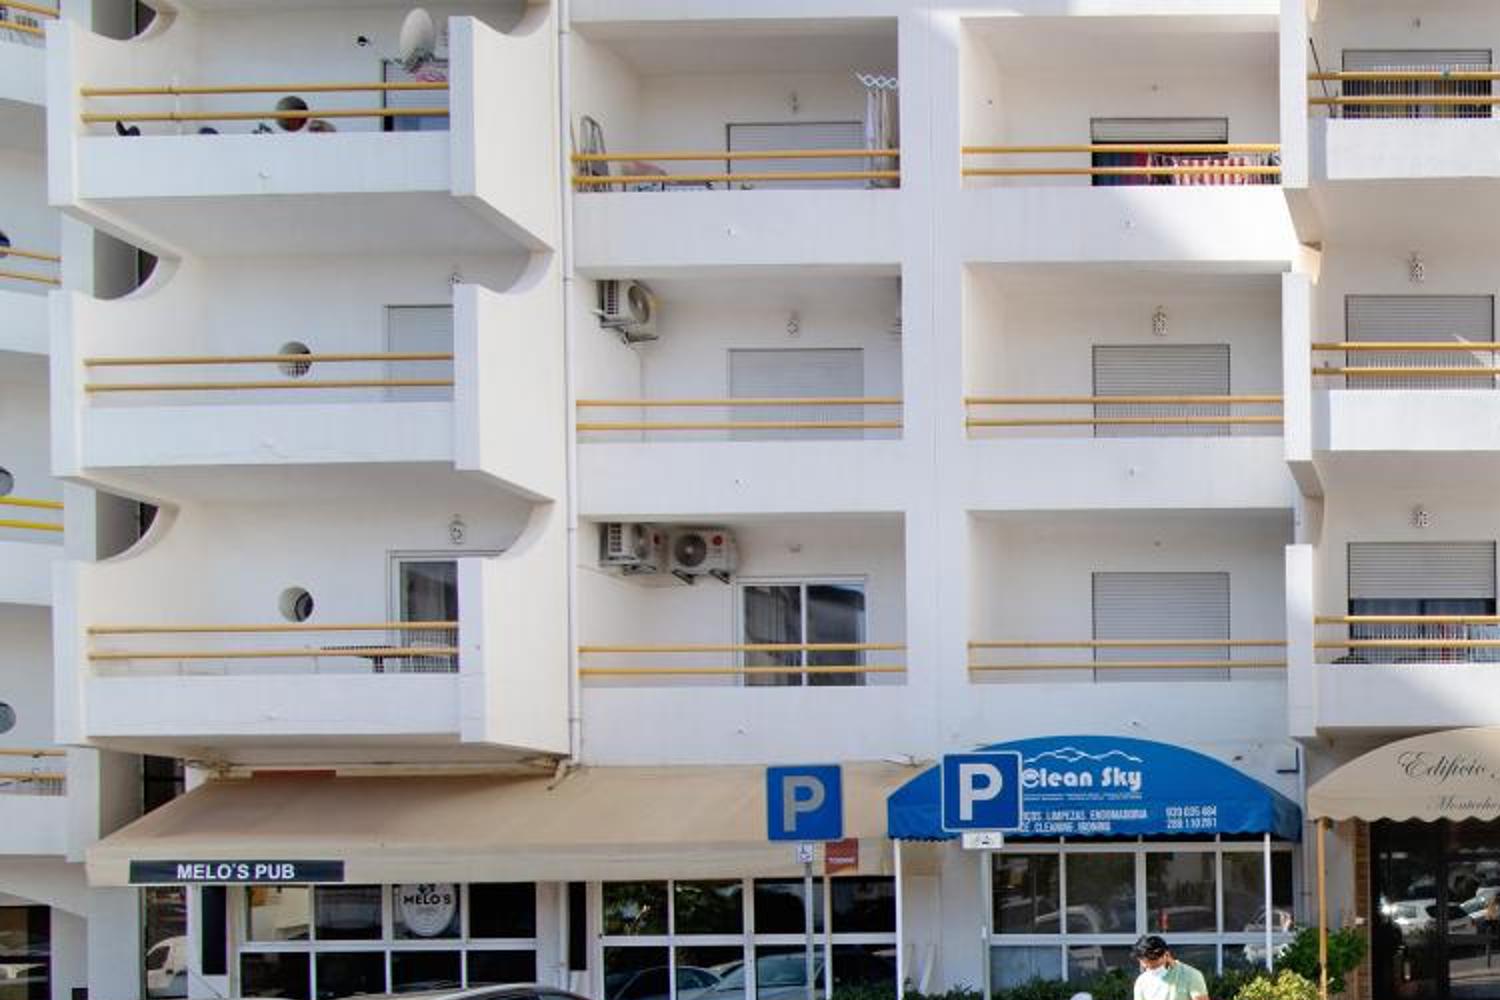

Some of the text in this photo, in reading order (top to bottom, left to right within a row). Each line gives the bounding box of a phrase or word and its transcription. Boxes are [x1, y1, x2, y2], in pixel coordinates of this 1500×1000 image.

[960, 763, 1003, 821] P
[1023, 766, 1143, 792] Clean Sky
[783, 775, 825, 832] P
[177, 863, 295, 880] MELO'S PUB
